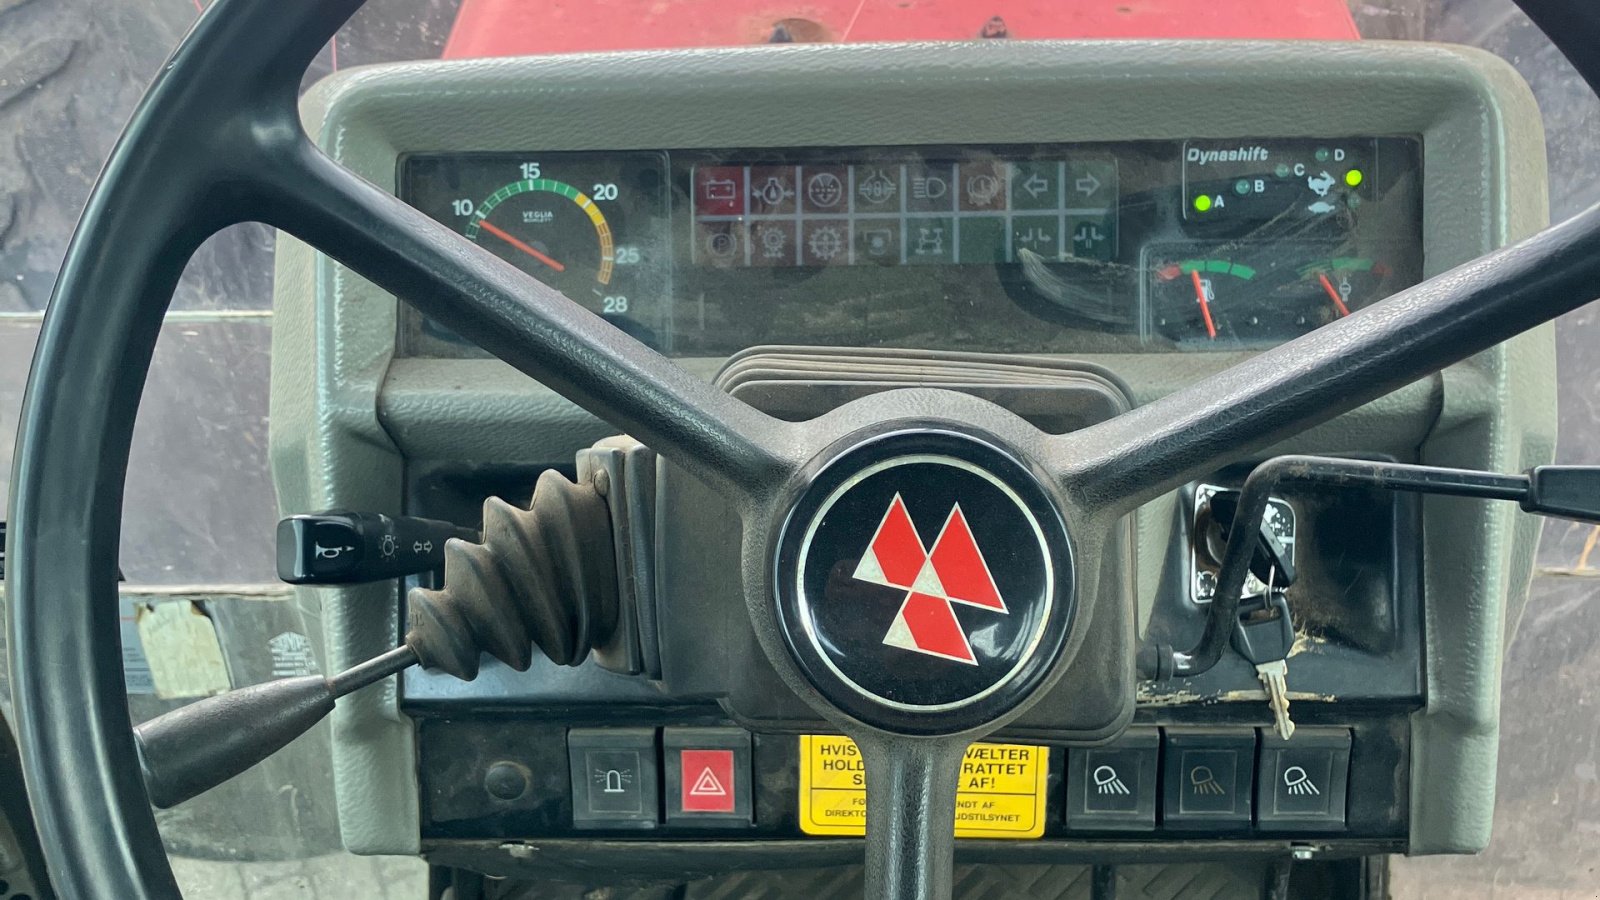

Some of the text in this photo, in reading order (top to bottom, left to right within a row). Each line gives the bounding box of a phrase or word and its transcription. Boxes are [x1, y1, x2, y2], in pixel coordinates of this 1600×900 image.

[1187, 147, 1269, 165] Dynashift
[1334, 149, 1345, 161] D
[520, 162, 541, 179] 15
[1293, 163, 1305, 176] C
[593, 183, 618, 201] 20
[1254, 179, 1265, 193] B
[452, 199, 473, 216] 10
[1214, 195, 1225, 208] A
[522, 210, 553, 218] VEGLIA
[616, 247, 640, 264] 25
[603, 296, 628, 313] 28
[820, 744, 857, 756] HVIS
[963, 763, 1027, 774] RATTET
[968, 777, 995, 788] AF!
[982, 801, 995, 809] AF
